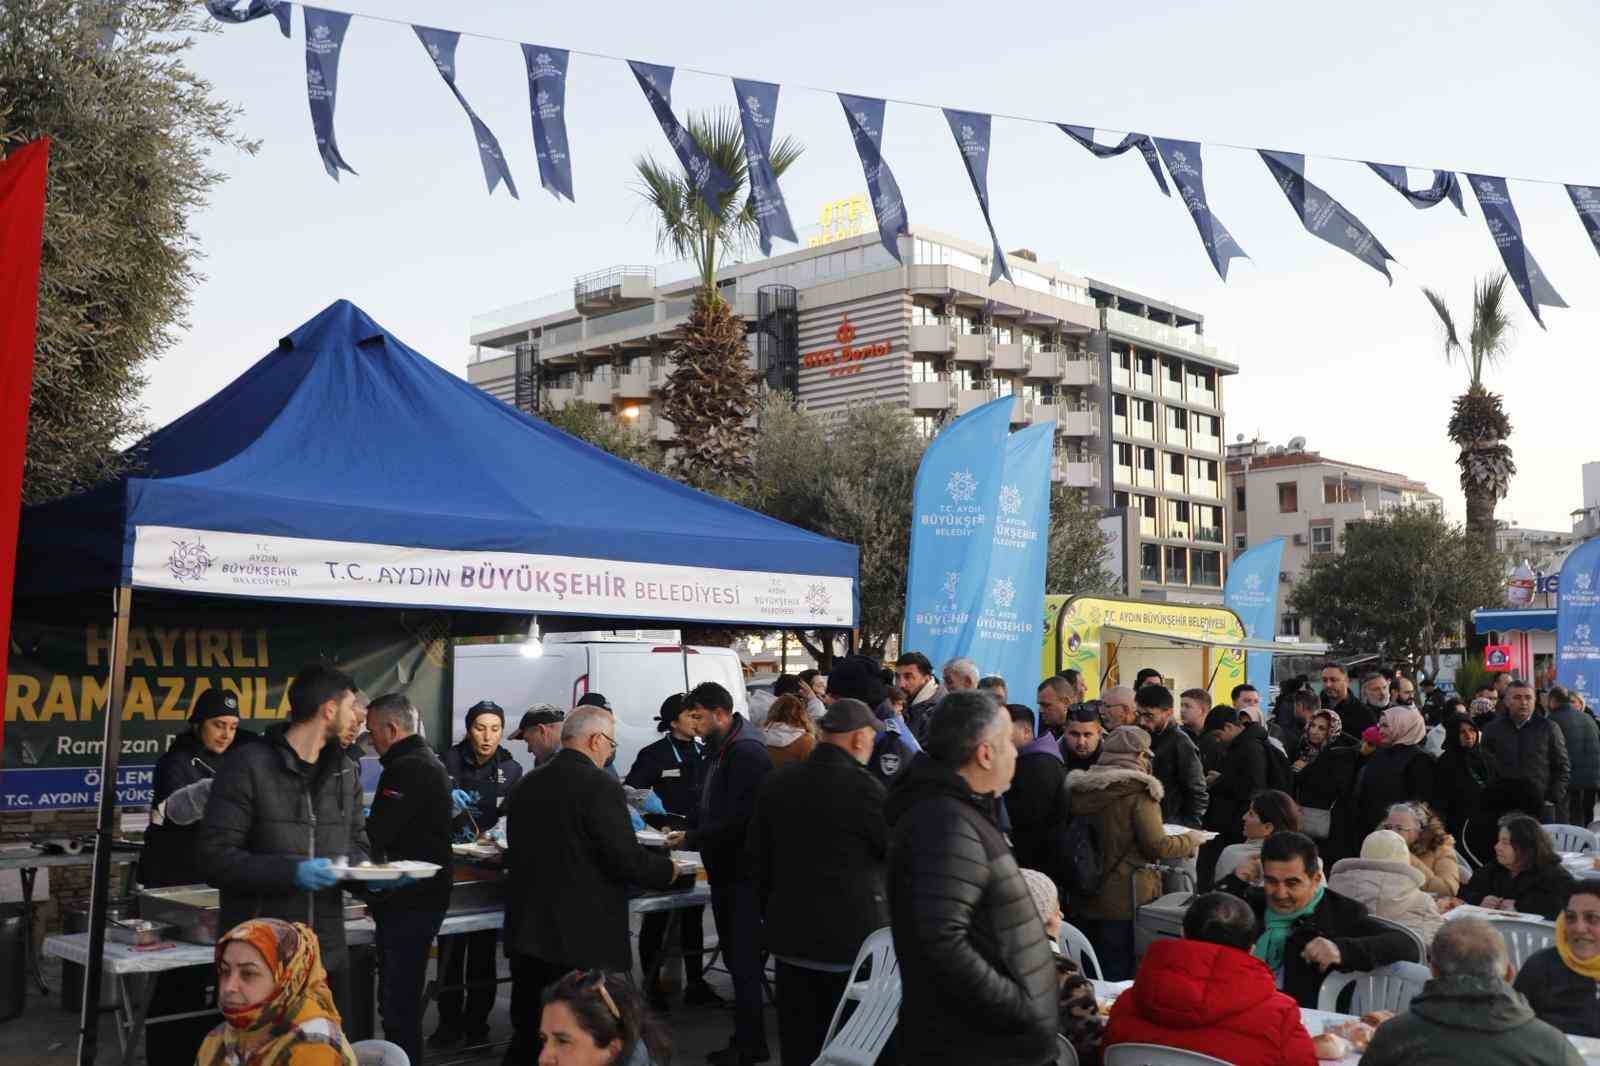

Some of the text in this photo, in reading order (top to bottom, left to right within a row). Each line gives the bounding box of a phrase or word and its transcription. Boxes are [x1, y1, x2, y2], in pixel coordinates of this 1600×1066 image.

[325, 561, 741, 605] T.C. AYDIN BÜYÜKŞEHİR BELEDİYESİ
[57, 735, 159, 755] Ramzan
[84, 769, 153, 787] ÖLEM
[5, 794, 33, 806] T.C.
[38, 791, 89, 805] AYDIN
